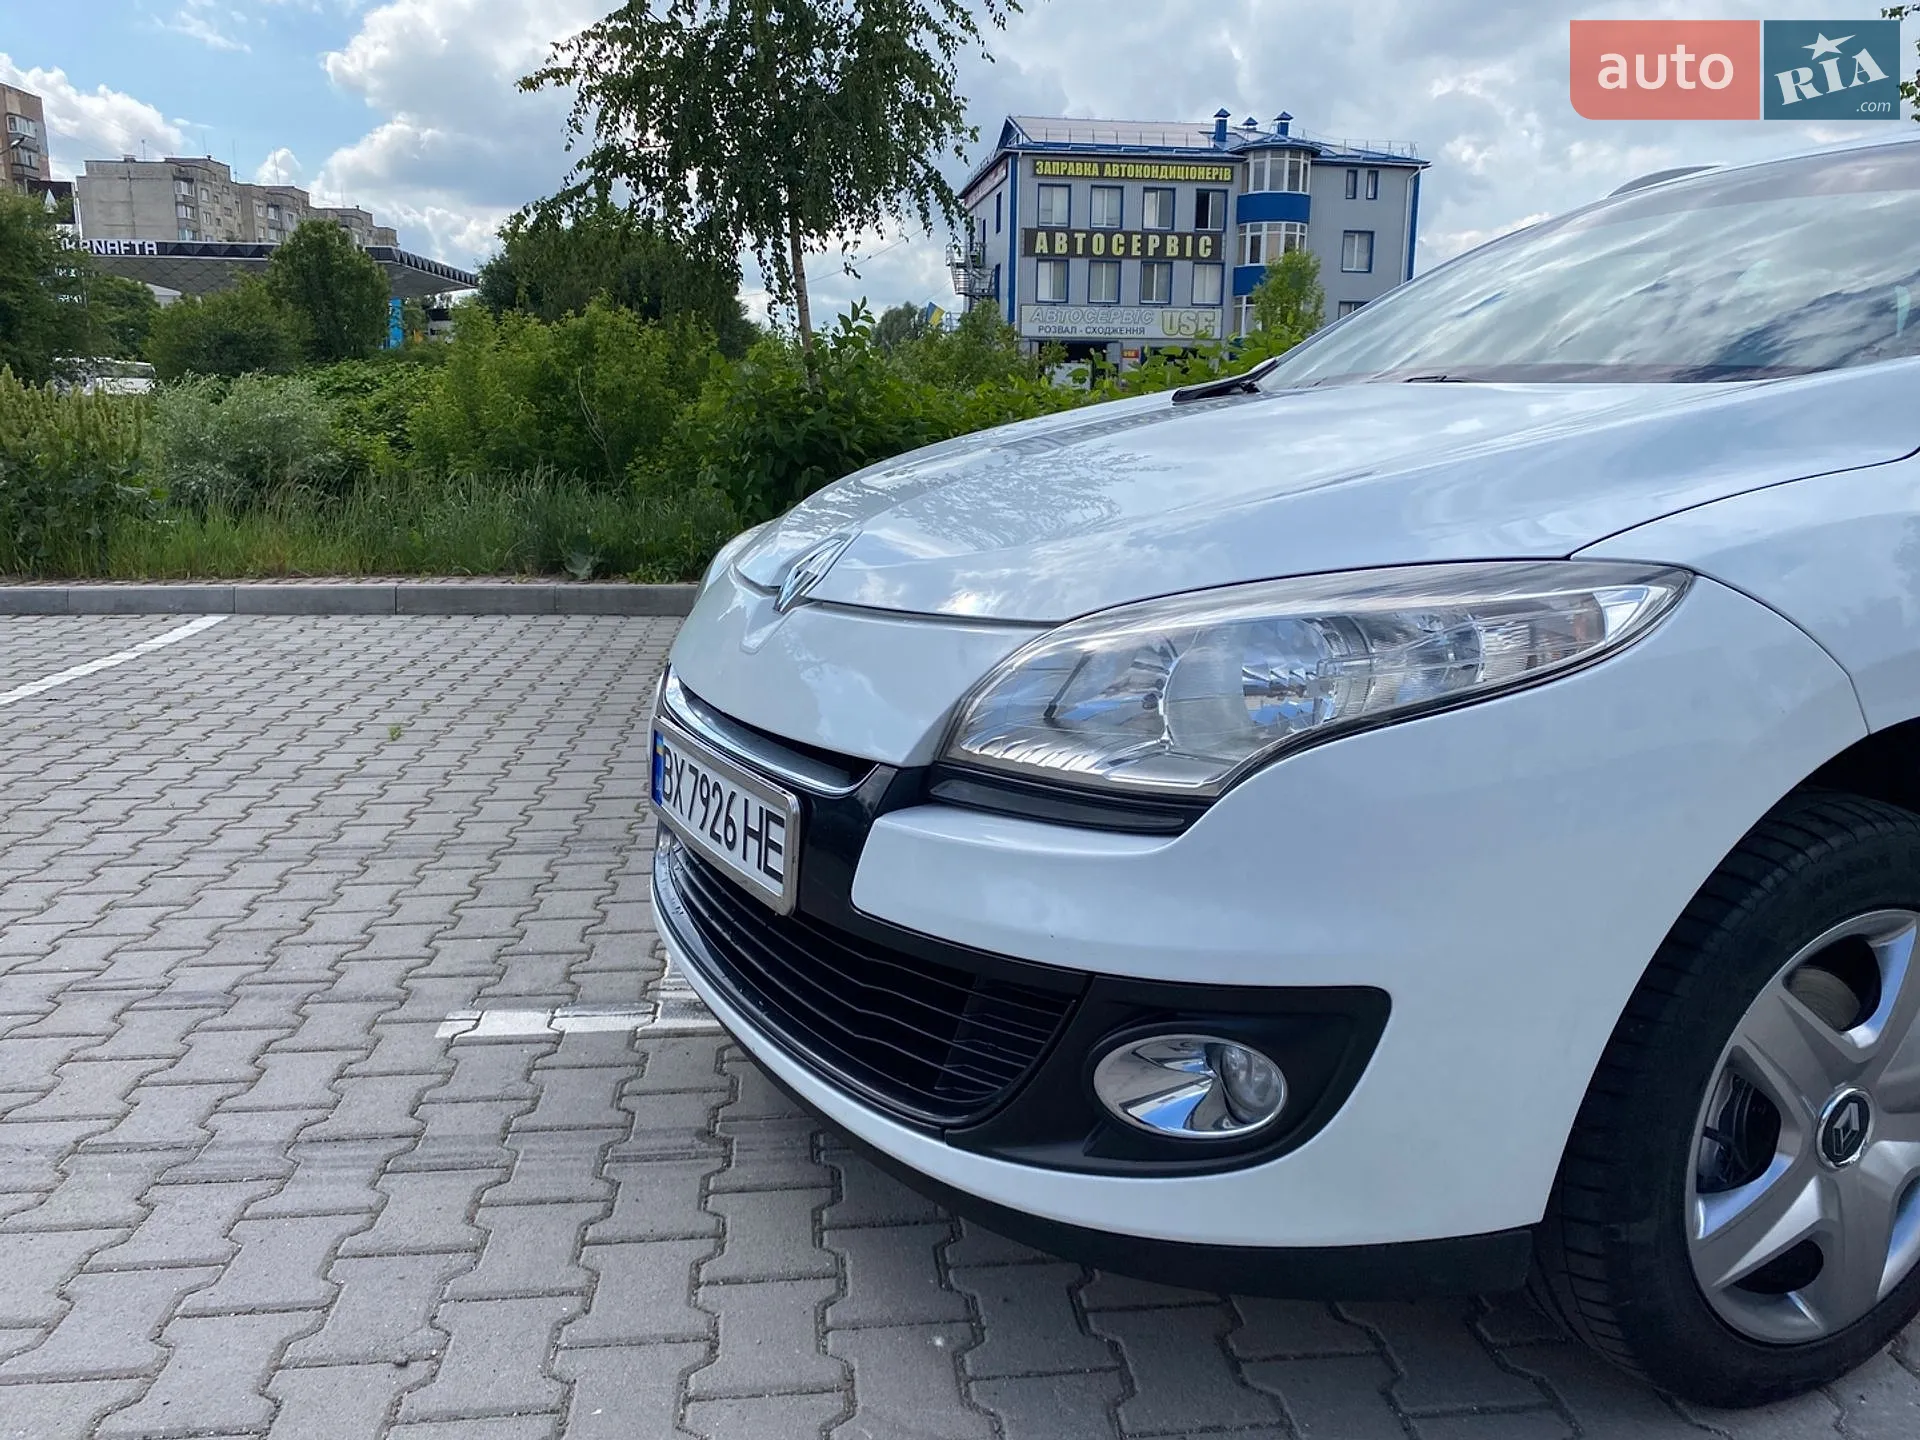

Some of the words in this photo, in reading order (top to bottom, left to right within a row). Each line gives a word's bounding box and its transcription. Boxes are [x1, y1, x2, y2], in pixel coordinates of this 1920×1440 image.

[1035, 161, 1099, 177] ЗАПРАВКА
[1103, 163, 1232, 181] АВТОКОНДИЦІОНЕРІВ
[1035, 231, 1213, 258] АВТОСЕРВІС
[1030, 307, 1154, 325] АВТОСЕРВІС
[1038, 325, 1077, 334] РОЗВАЛ
[1085, 326, 1145, 336] СХОДЖЕННЯ
[687, 766, 737, 851] 7926
